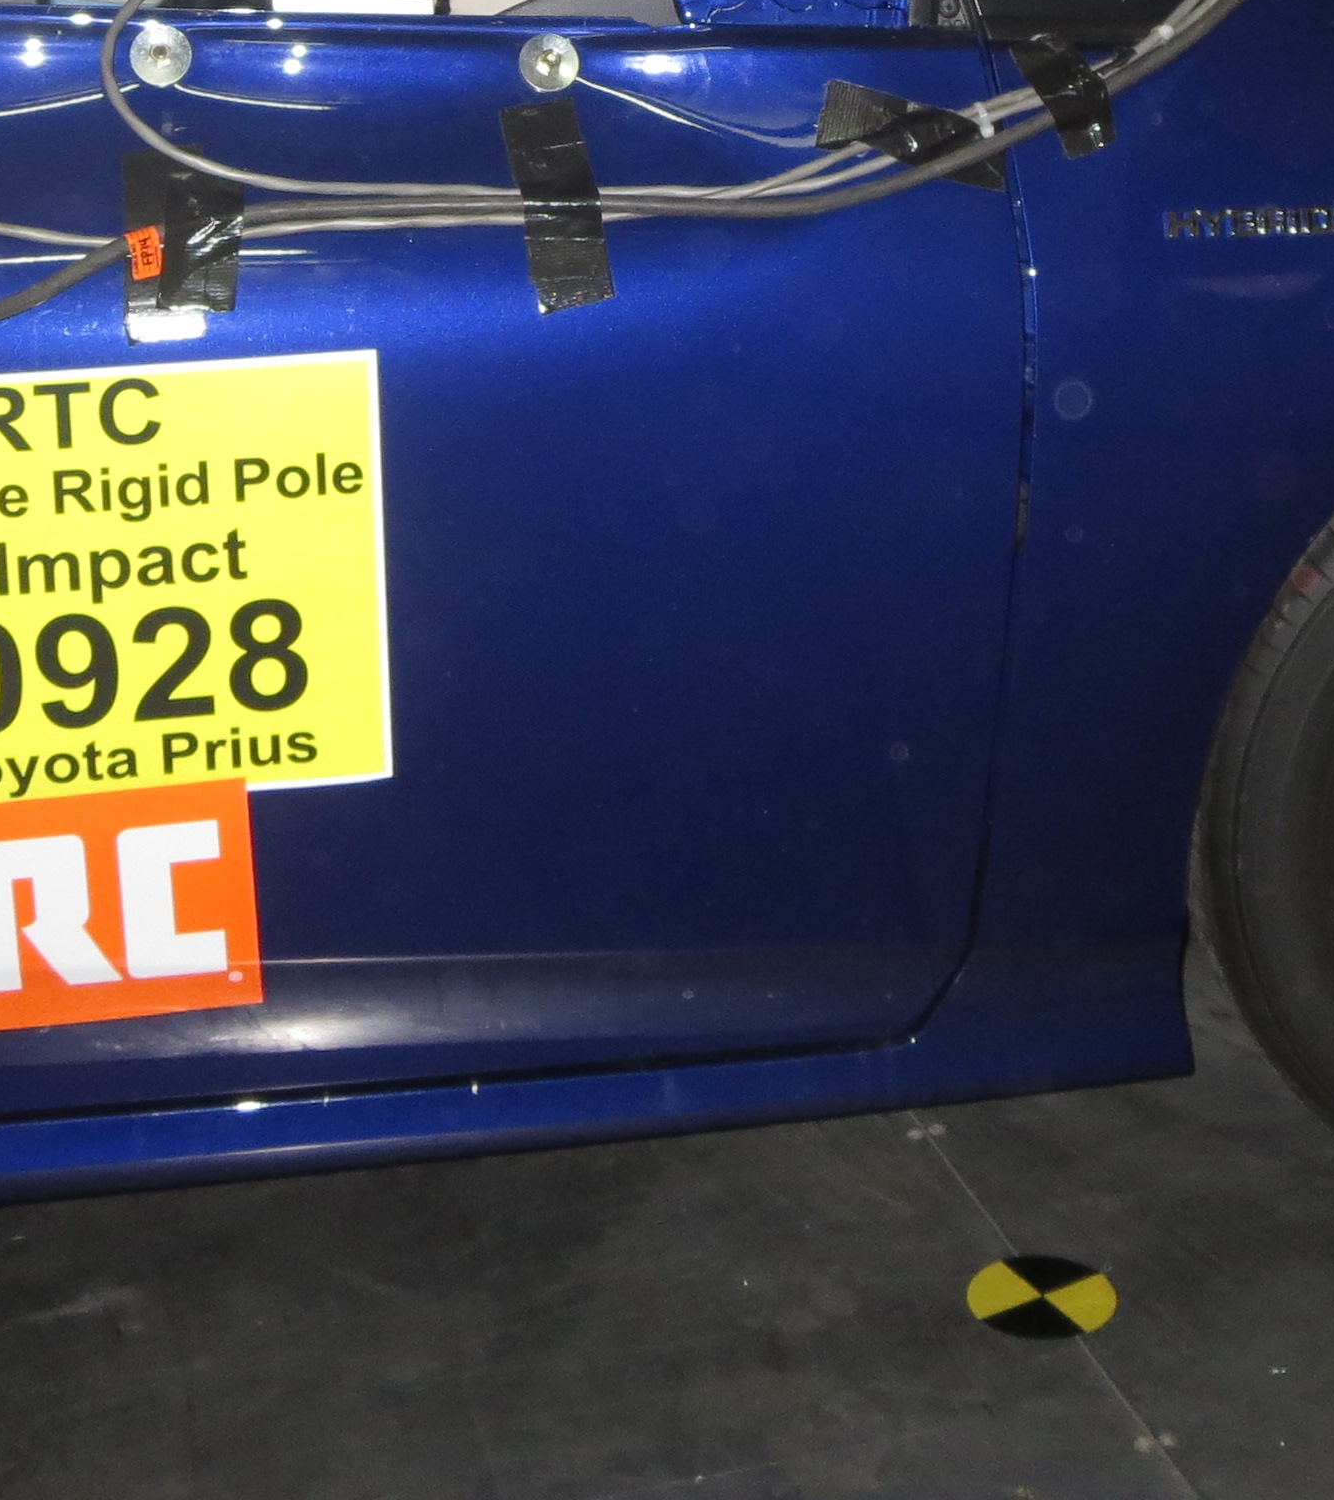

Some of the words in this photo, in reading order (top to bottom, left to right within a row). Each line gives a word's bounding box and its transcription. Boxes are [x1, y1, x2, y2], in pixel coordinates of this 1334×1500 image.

[1162, 207, 1334, 239] HYBRID
[52, 459, 210, 523] Rigid
[233, 452, 364, 503] Pole
[161, 729, 318, 775] Prius
